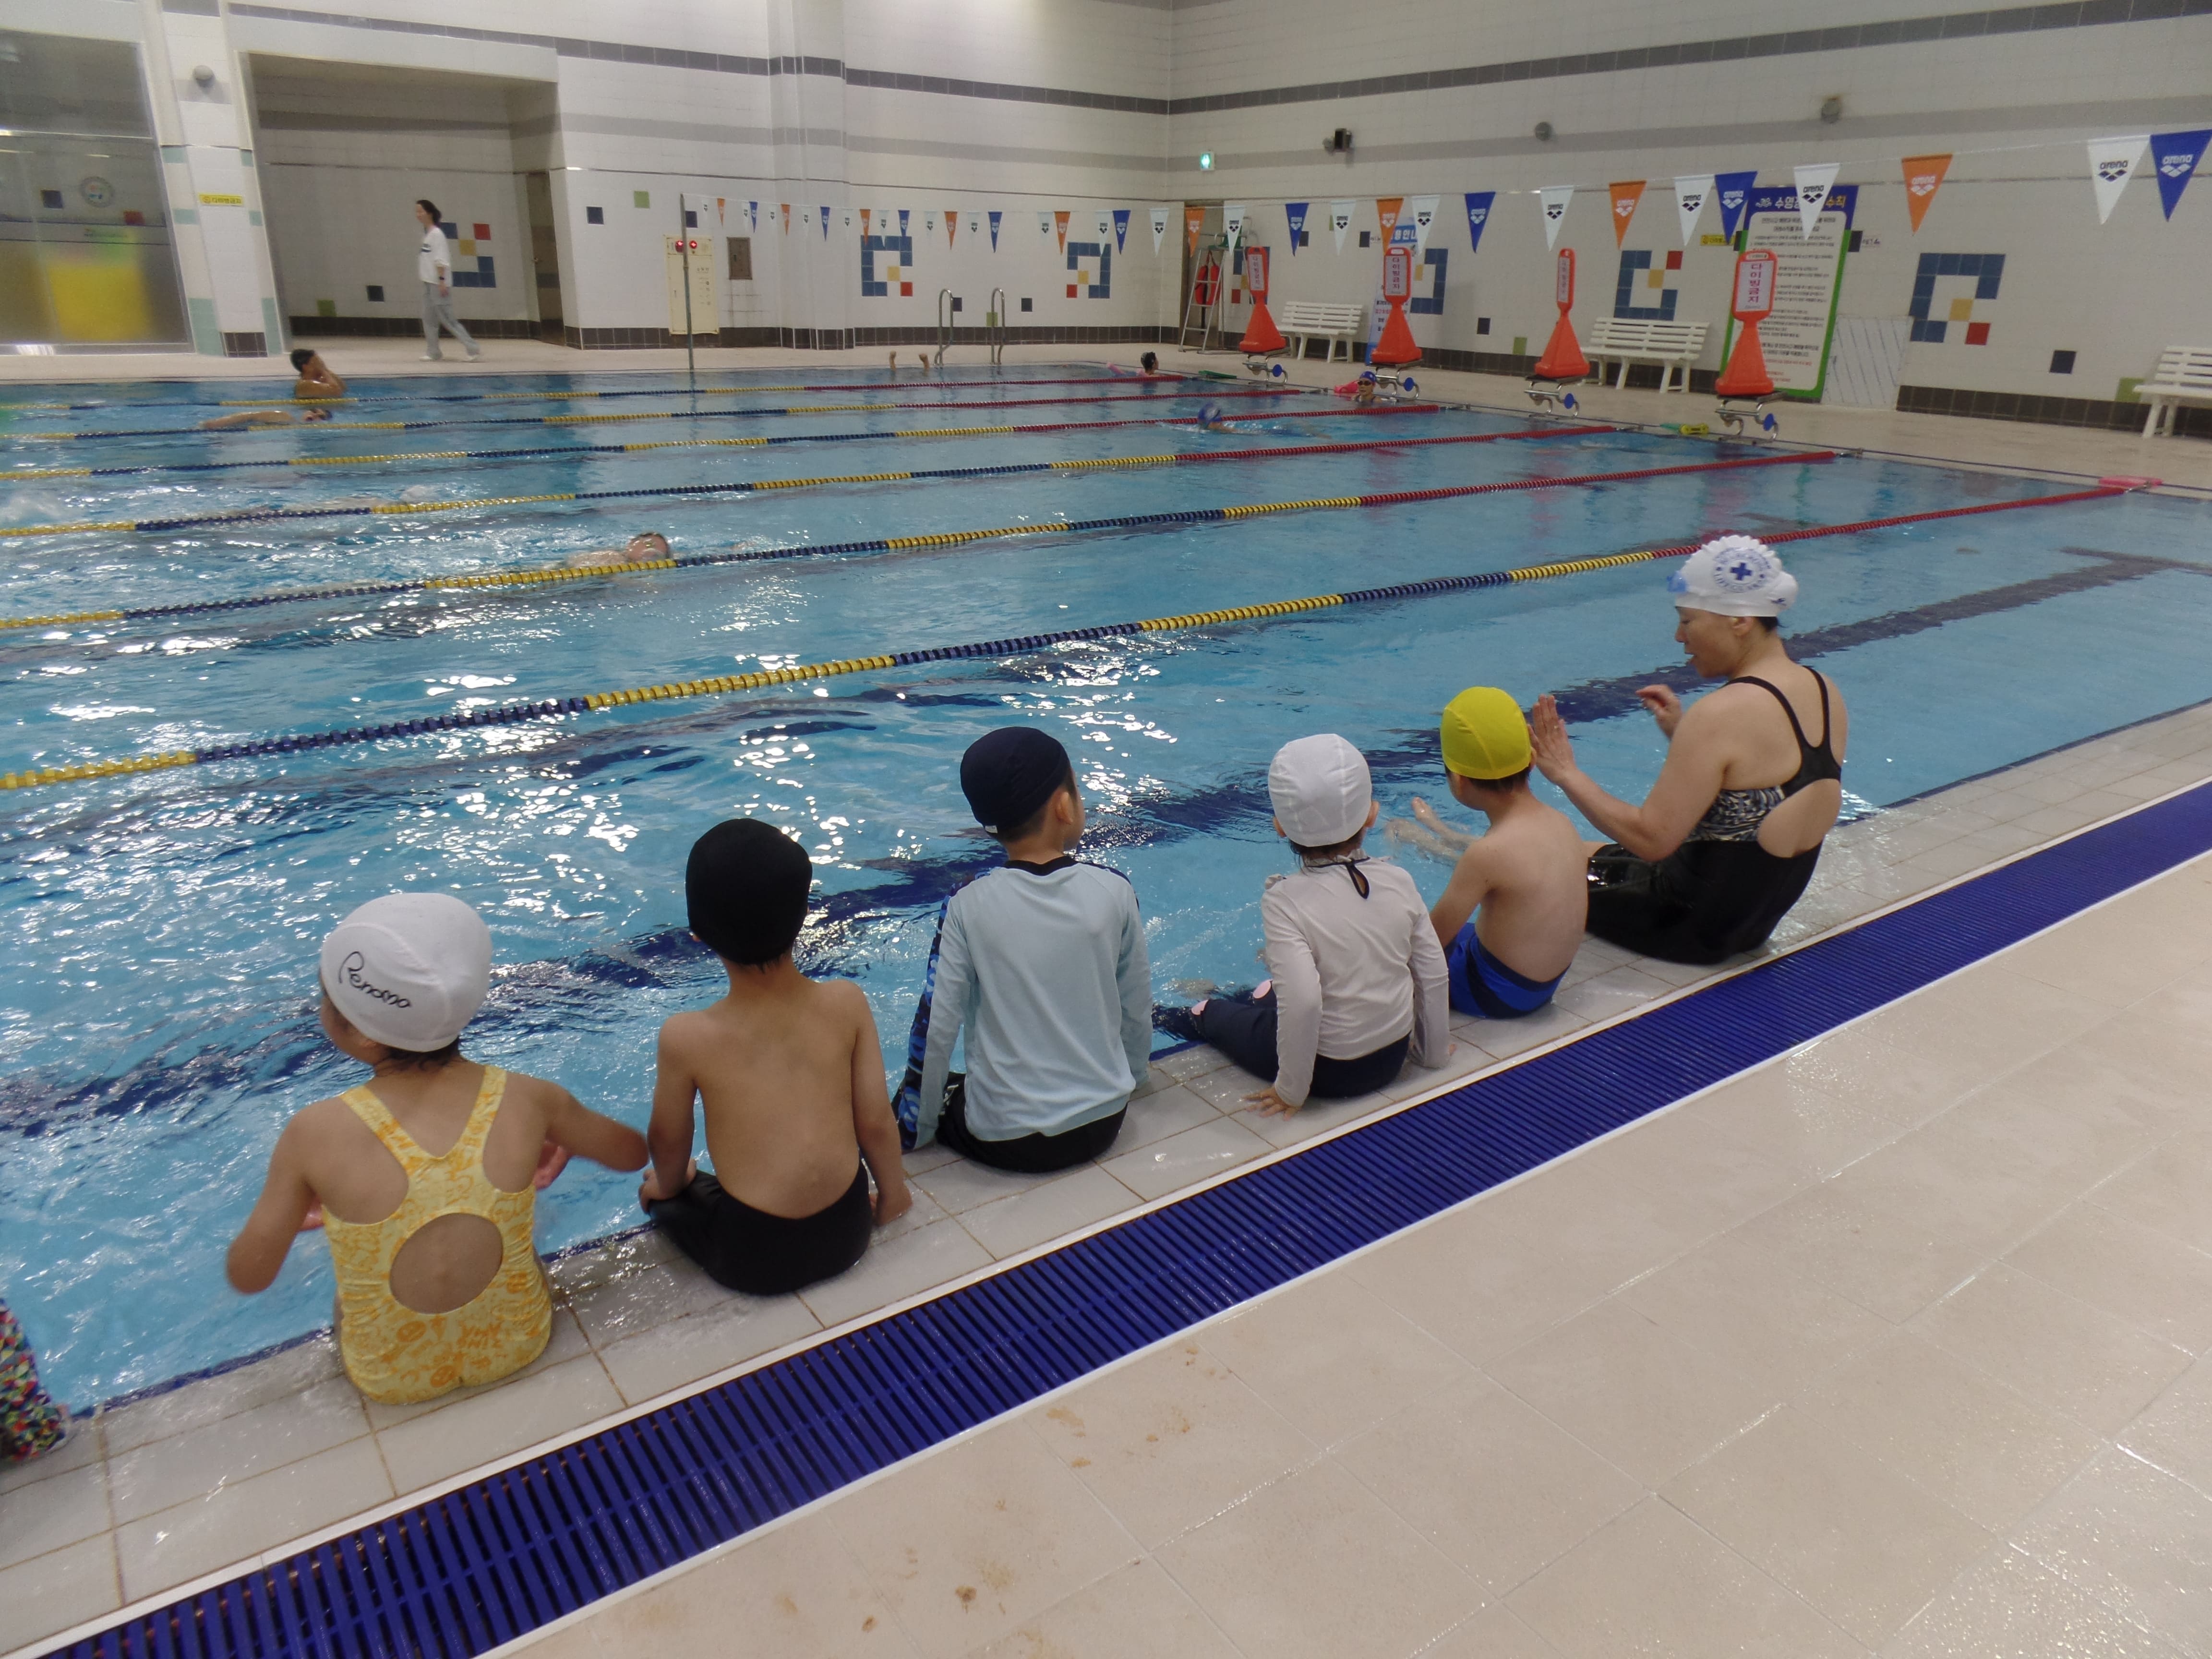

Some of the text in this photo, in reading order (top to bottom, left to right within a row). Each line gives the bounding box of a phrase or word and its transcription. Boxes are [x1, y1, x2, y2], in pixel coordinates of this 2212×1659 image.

[2163, 154, 2193, 164] arena
[2100, 160, 2128, 169] arena
[1911, 175, 1936, 184] arena
[1748, 263, 1762, 302] 다이빙금지
